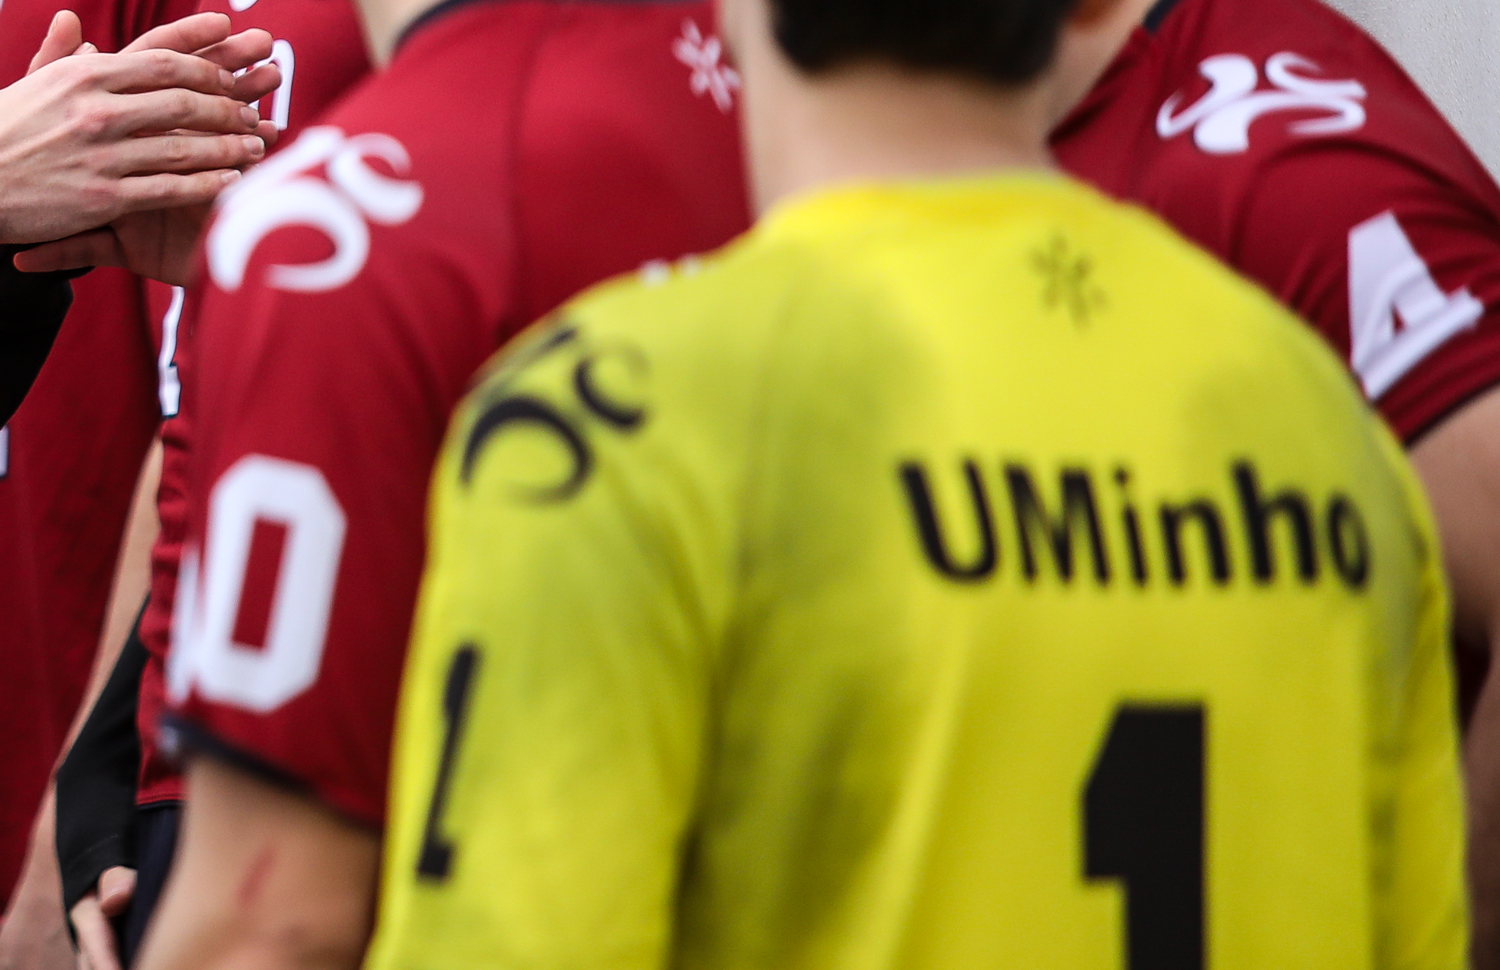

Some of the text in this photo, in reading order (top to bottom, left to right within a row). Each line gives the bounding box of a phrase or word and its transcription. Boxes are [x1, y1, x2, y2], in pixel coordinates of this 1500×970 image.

[1348, 210, 1484, 401] 4
[898, 457, 1373, 590] UMinho
[1079, 700, 1207, 970] 1
